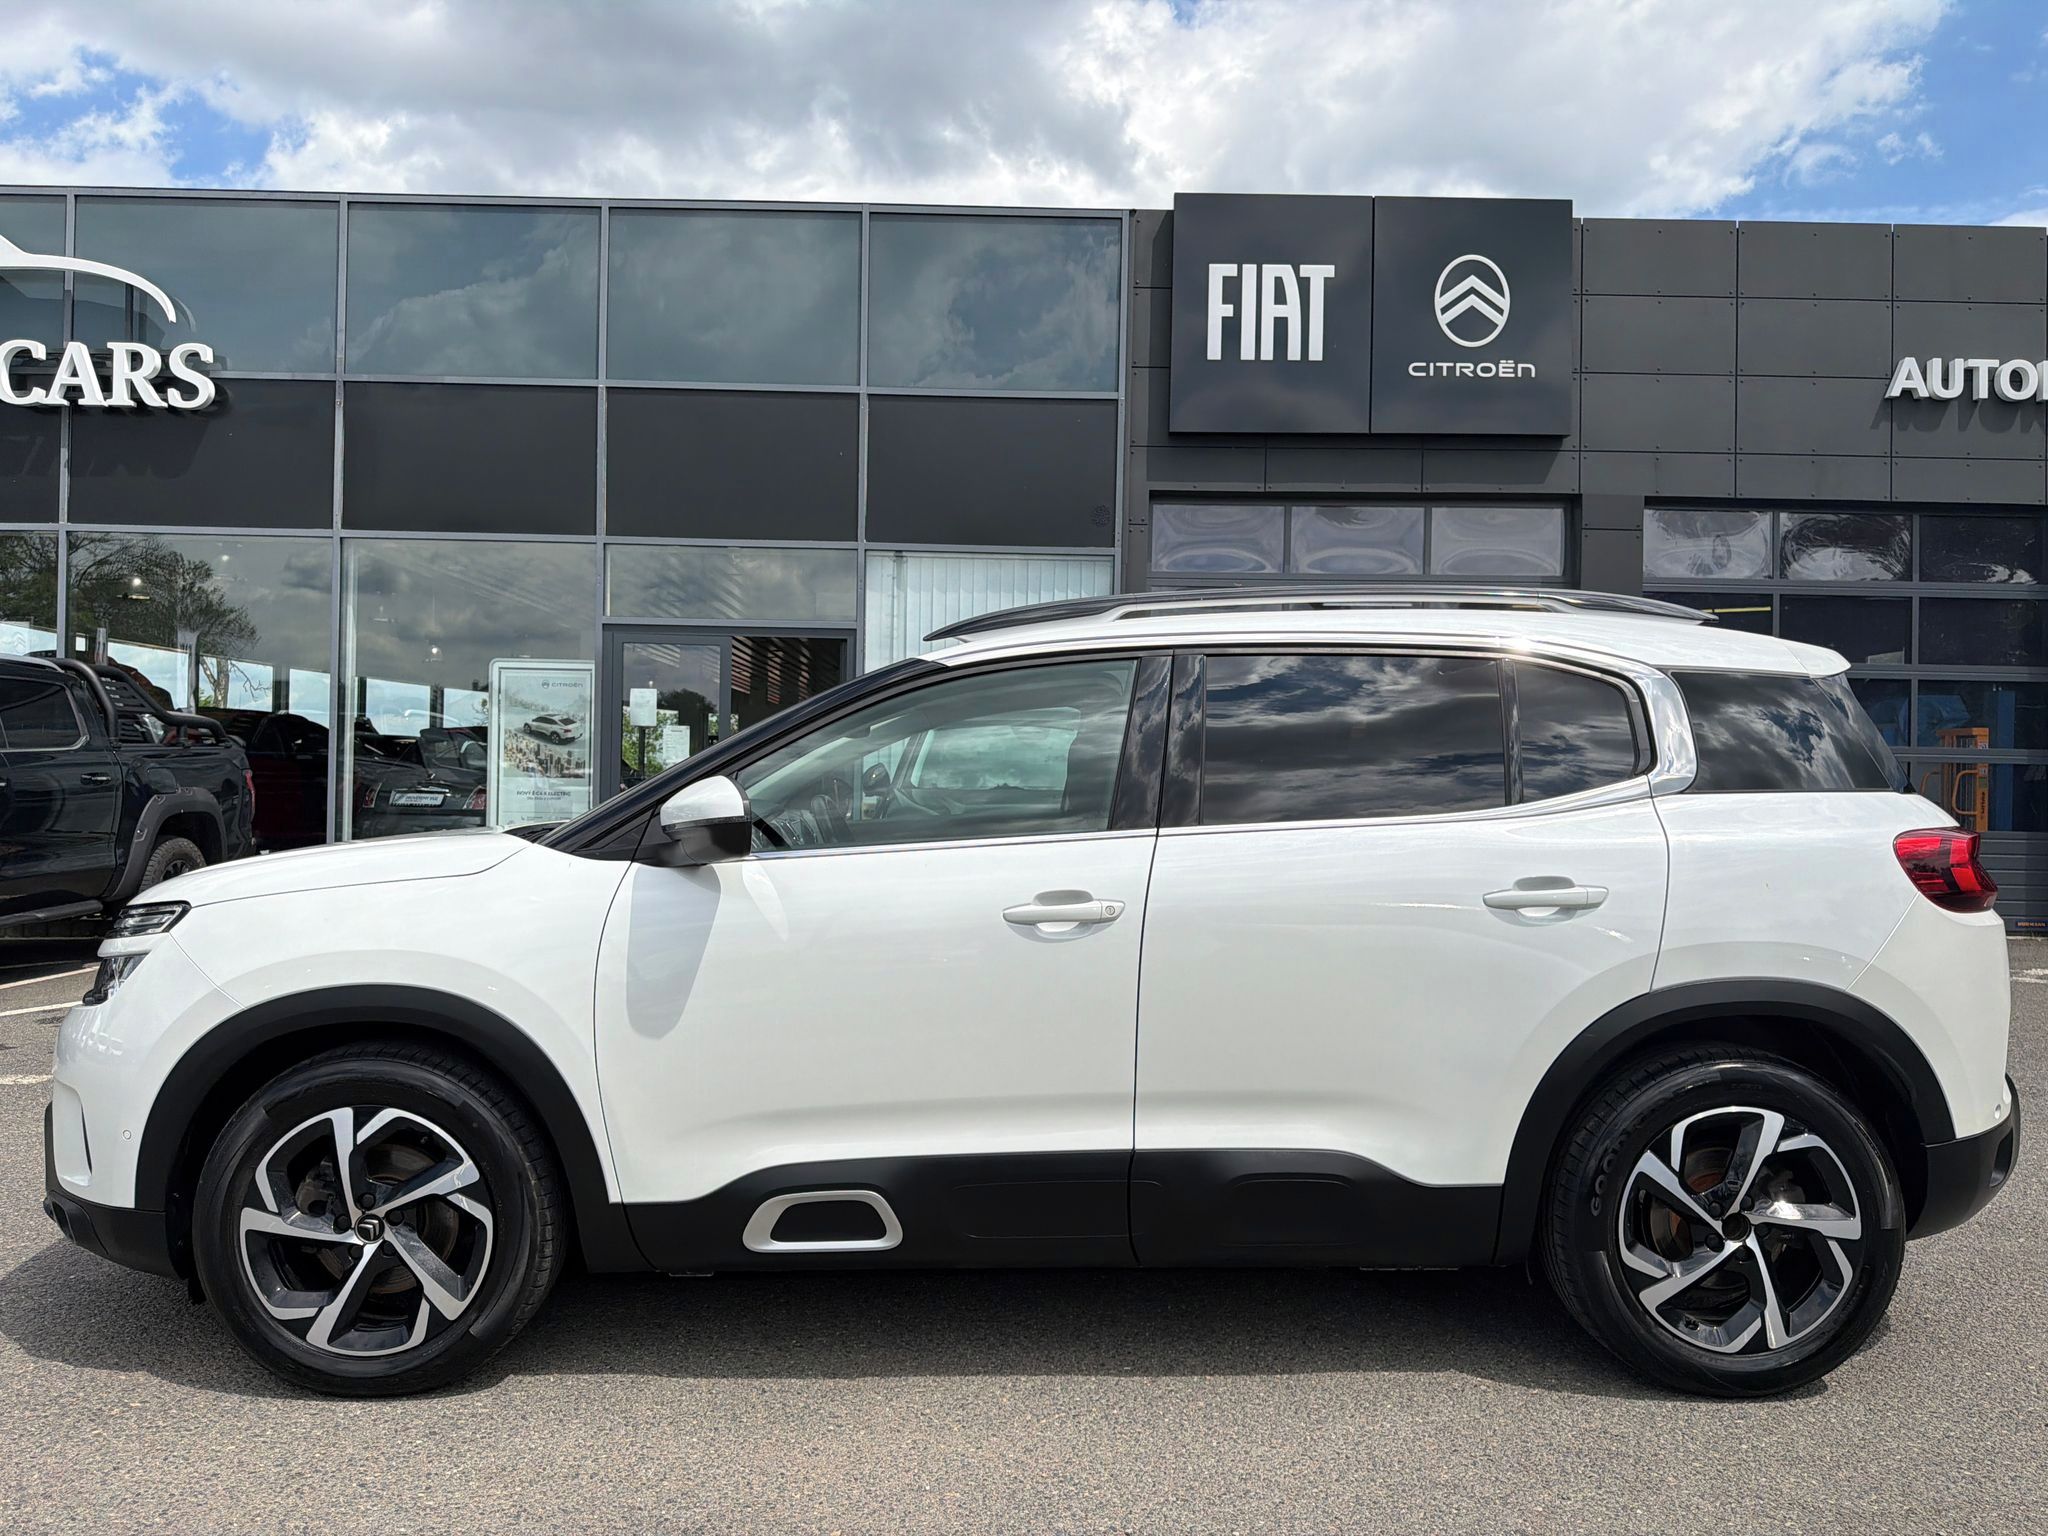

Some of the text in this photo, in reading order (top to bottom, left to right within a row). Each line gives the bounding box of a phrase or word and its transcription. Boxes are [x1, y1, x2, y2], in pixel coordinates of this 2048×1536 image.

[1207, 263, 1335, 361] FIAT
[0, 339, 216, 411] CARS
[1408, 360, 1536, 378] CITROËN
